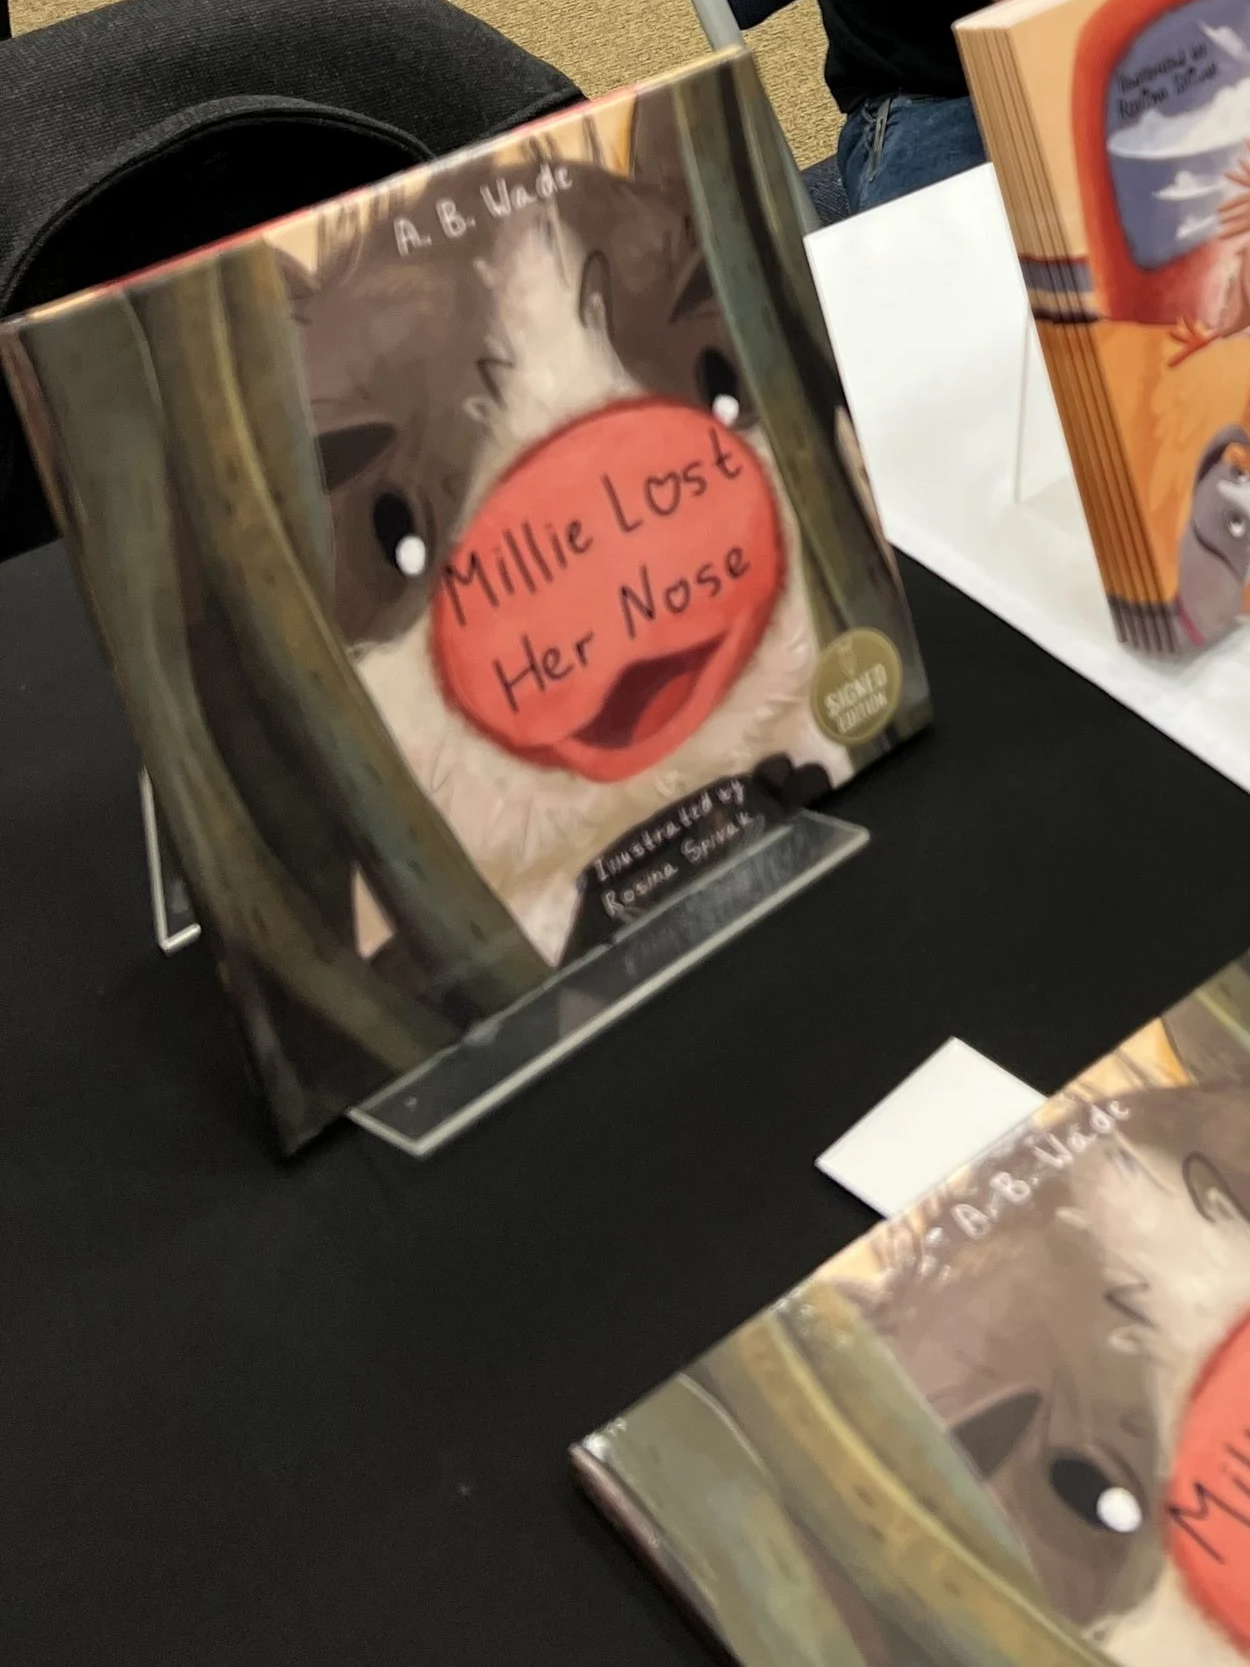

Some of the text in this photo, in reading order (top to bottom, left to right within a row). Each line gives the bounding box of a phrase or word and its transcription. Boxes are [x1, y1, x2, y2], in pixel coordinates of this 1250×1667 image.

[479, 163, 573, 218] Wade
[442, 426, 742, 627] Millie Lost
[493, 546, 750, 713] Her Nose
[824, 663, 888, 718] SIGNED
[593, 792, 714, 882] Illustrated
[602, 811, 754, 918] Rosina Spivak
[1033, 1100, 1130, 1169] Wade
